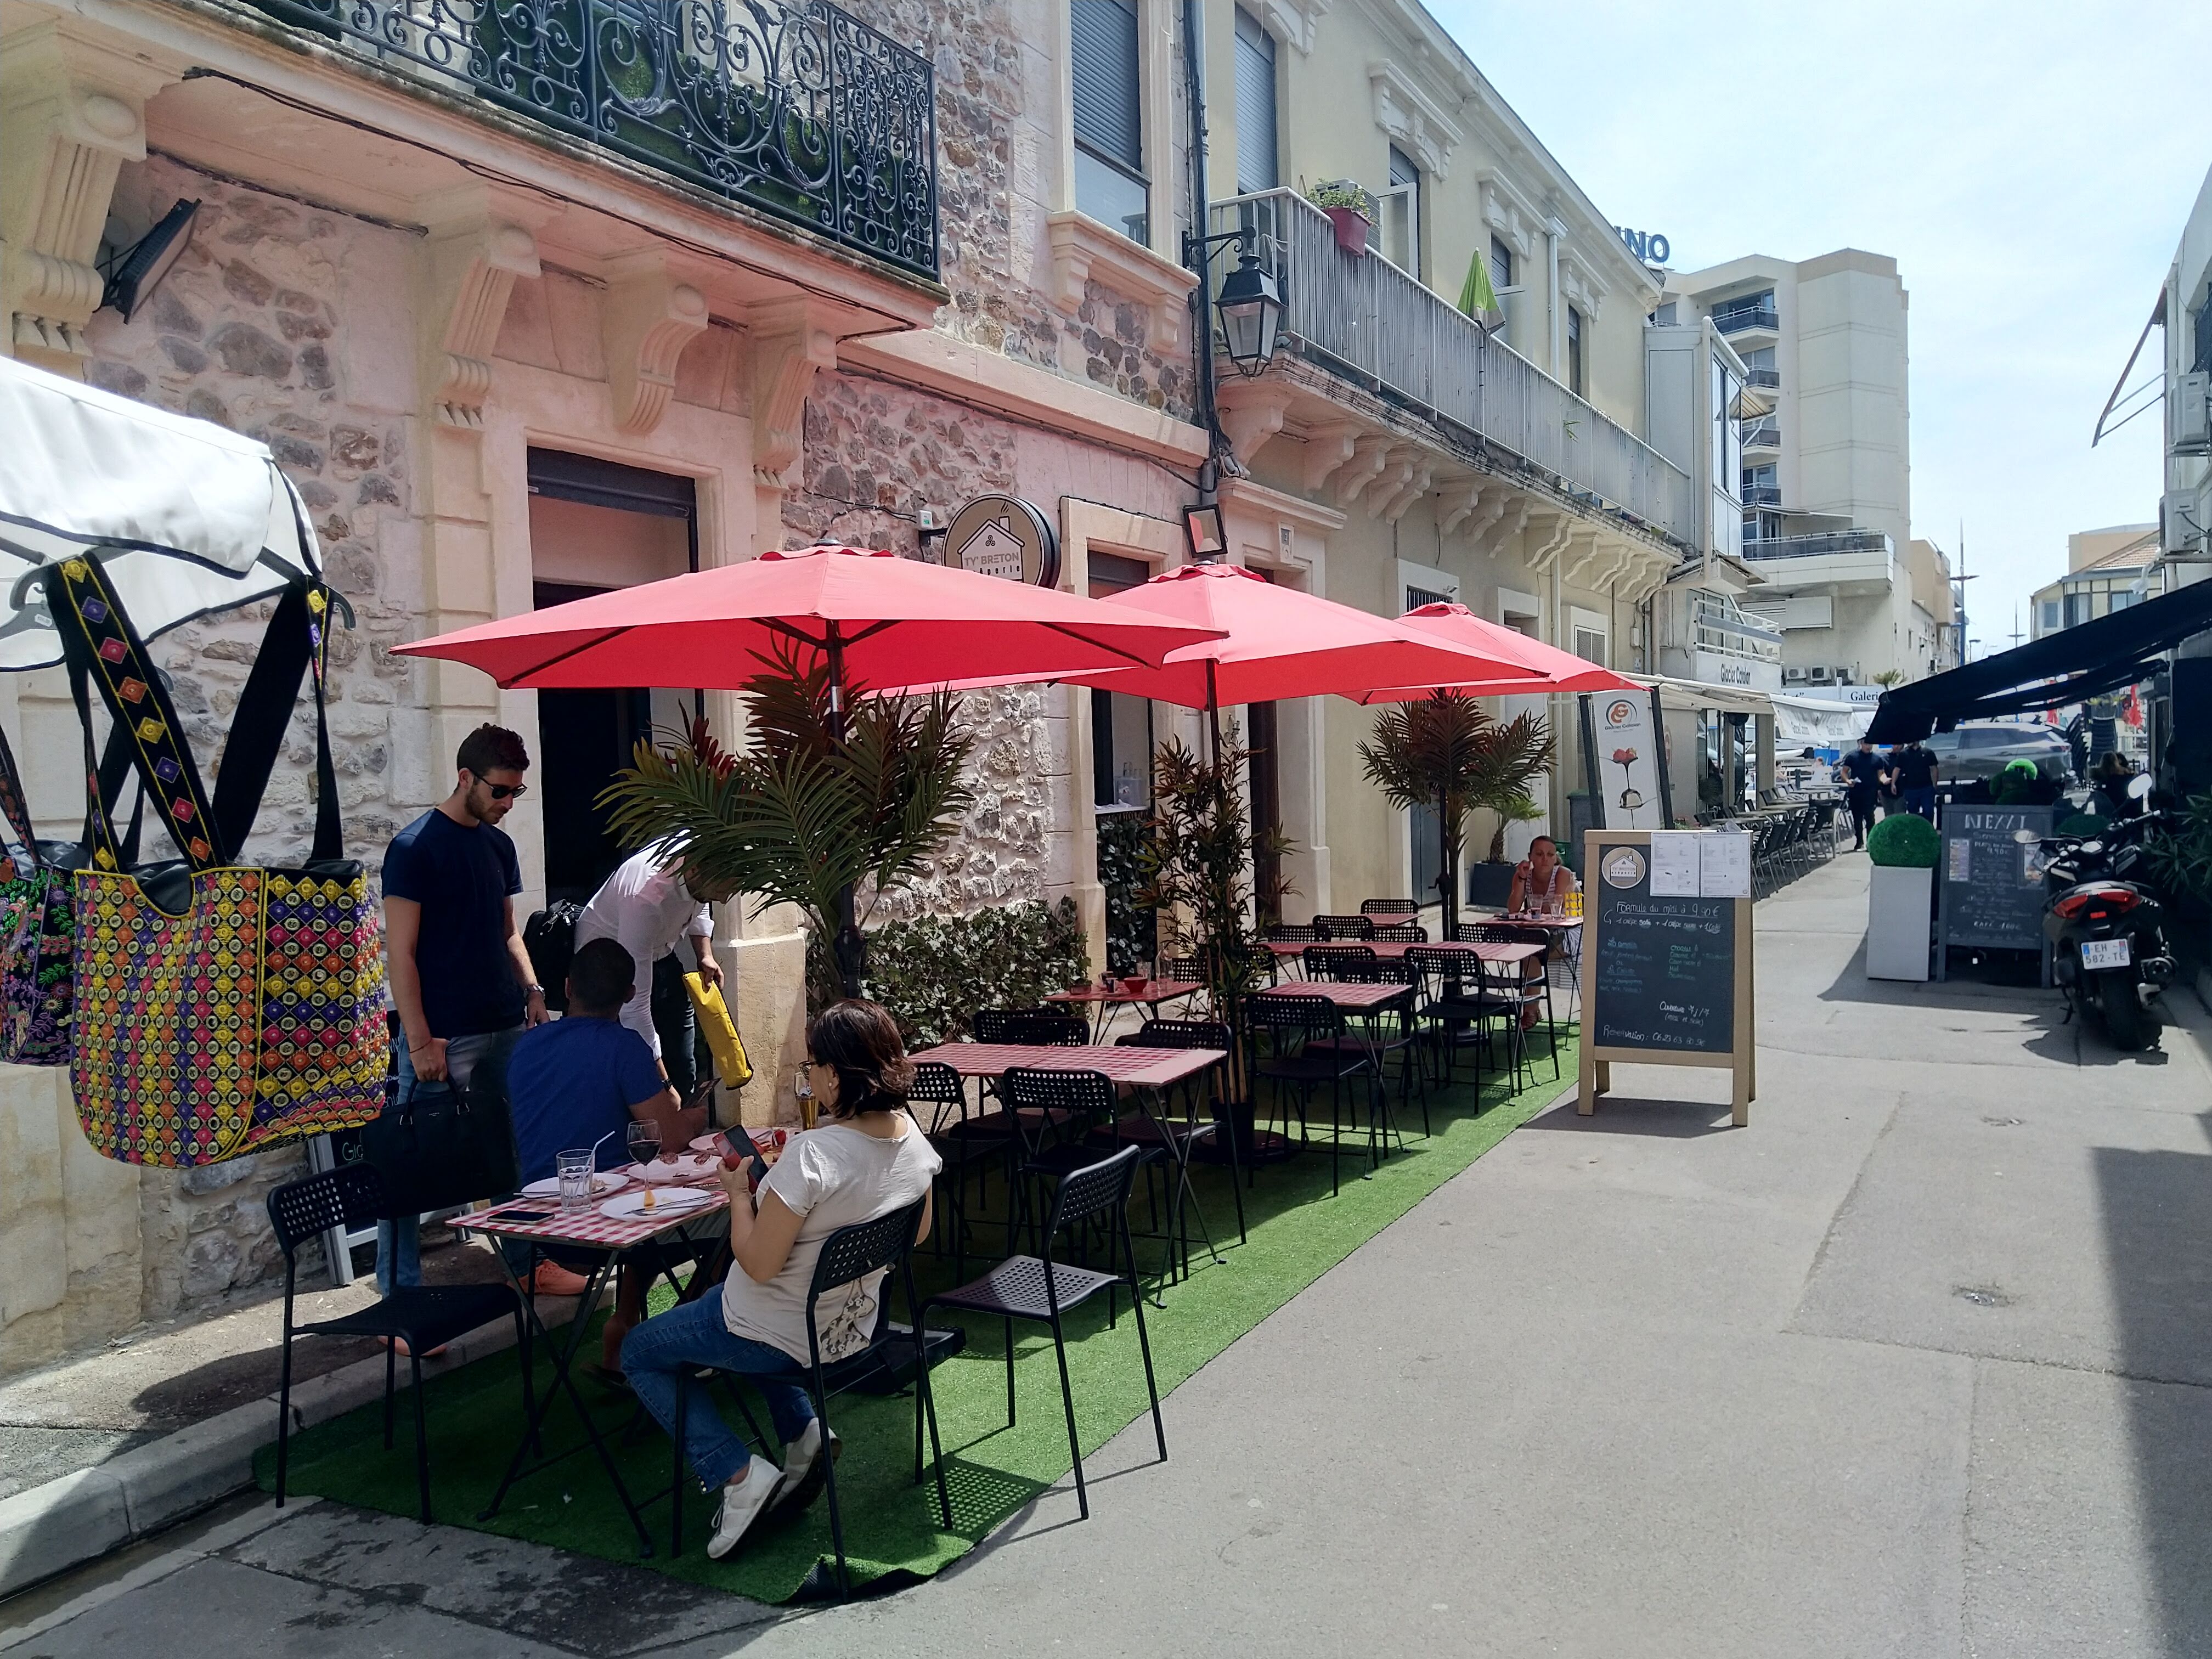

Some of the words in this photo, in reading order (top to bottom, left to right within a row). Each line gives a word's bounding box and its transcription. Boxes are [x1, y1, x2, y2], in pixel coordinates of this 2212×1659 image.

[964, 556, 979, 567] TY'
[980, 551, 1019, 565] BRETON
[972, 565, 1020, 576] êperie
[1720, 663, 1736, 684] Glacier
[1736, 665, 1751, 685] Catalan
[1649, 904, 1659, 912] du
